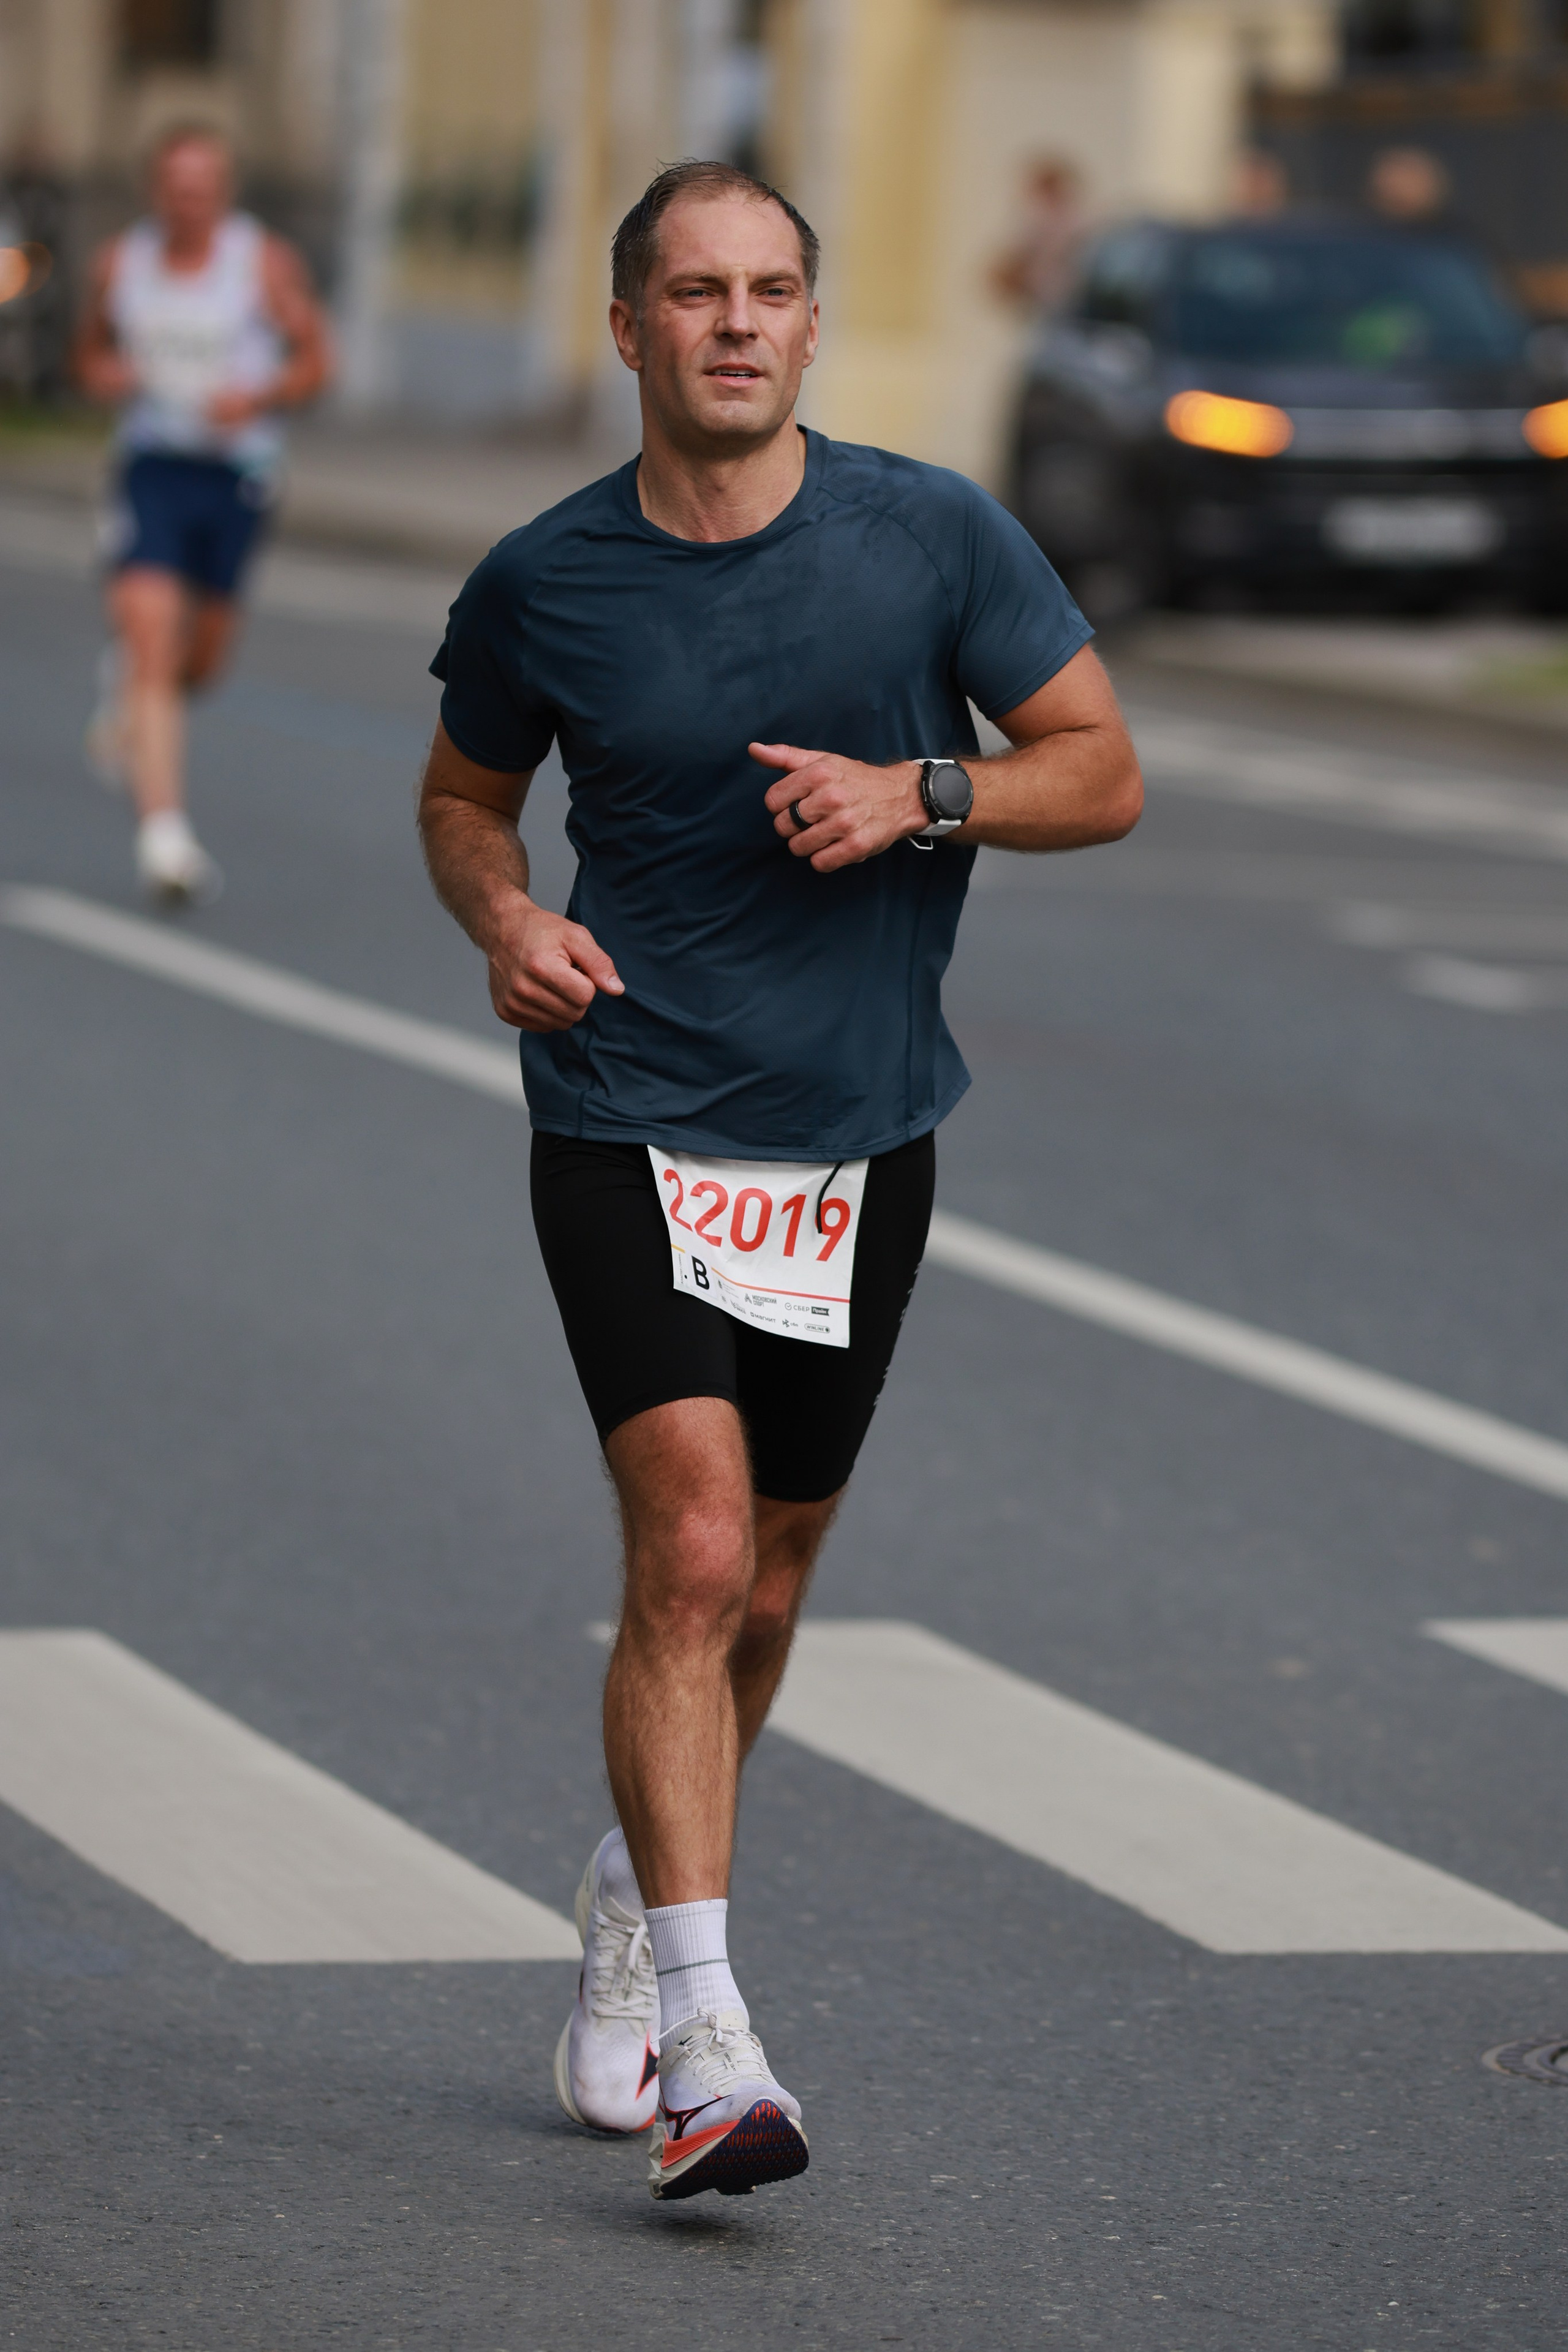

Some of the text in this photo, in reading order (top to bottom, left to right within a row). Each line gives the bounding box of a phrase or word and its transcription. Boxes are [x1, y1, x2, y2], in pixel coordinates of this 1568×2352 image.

[663, 1169, 850, 1261] 22019
[692, 1255, 710, 1290] B
[752, 1295, 777, 1304] МОСКОВСКИЙ
